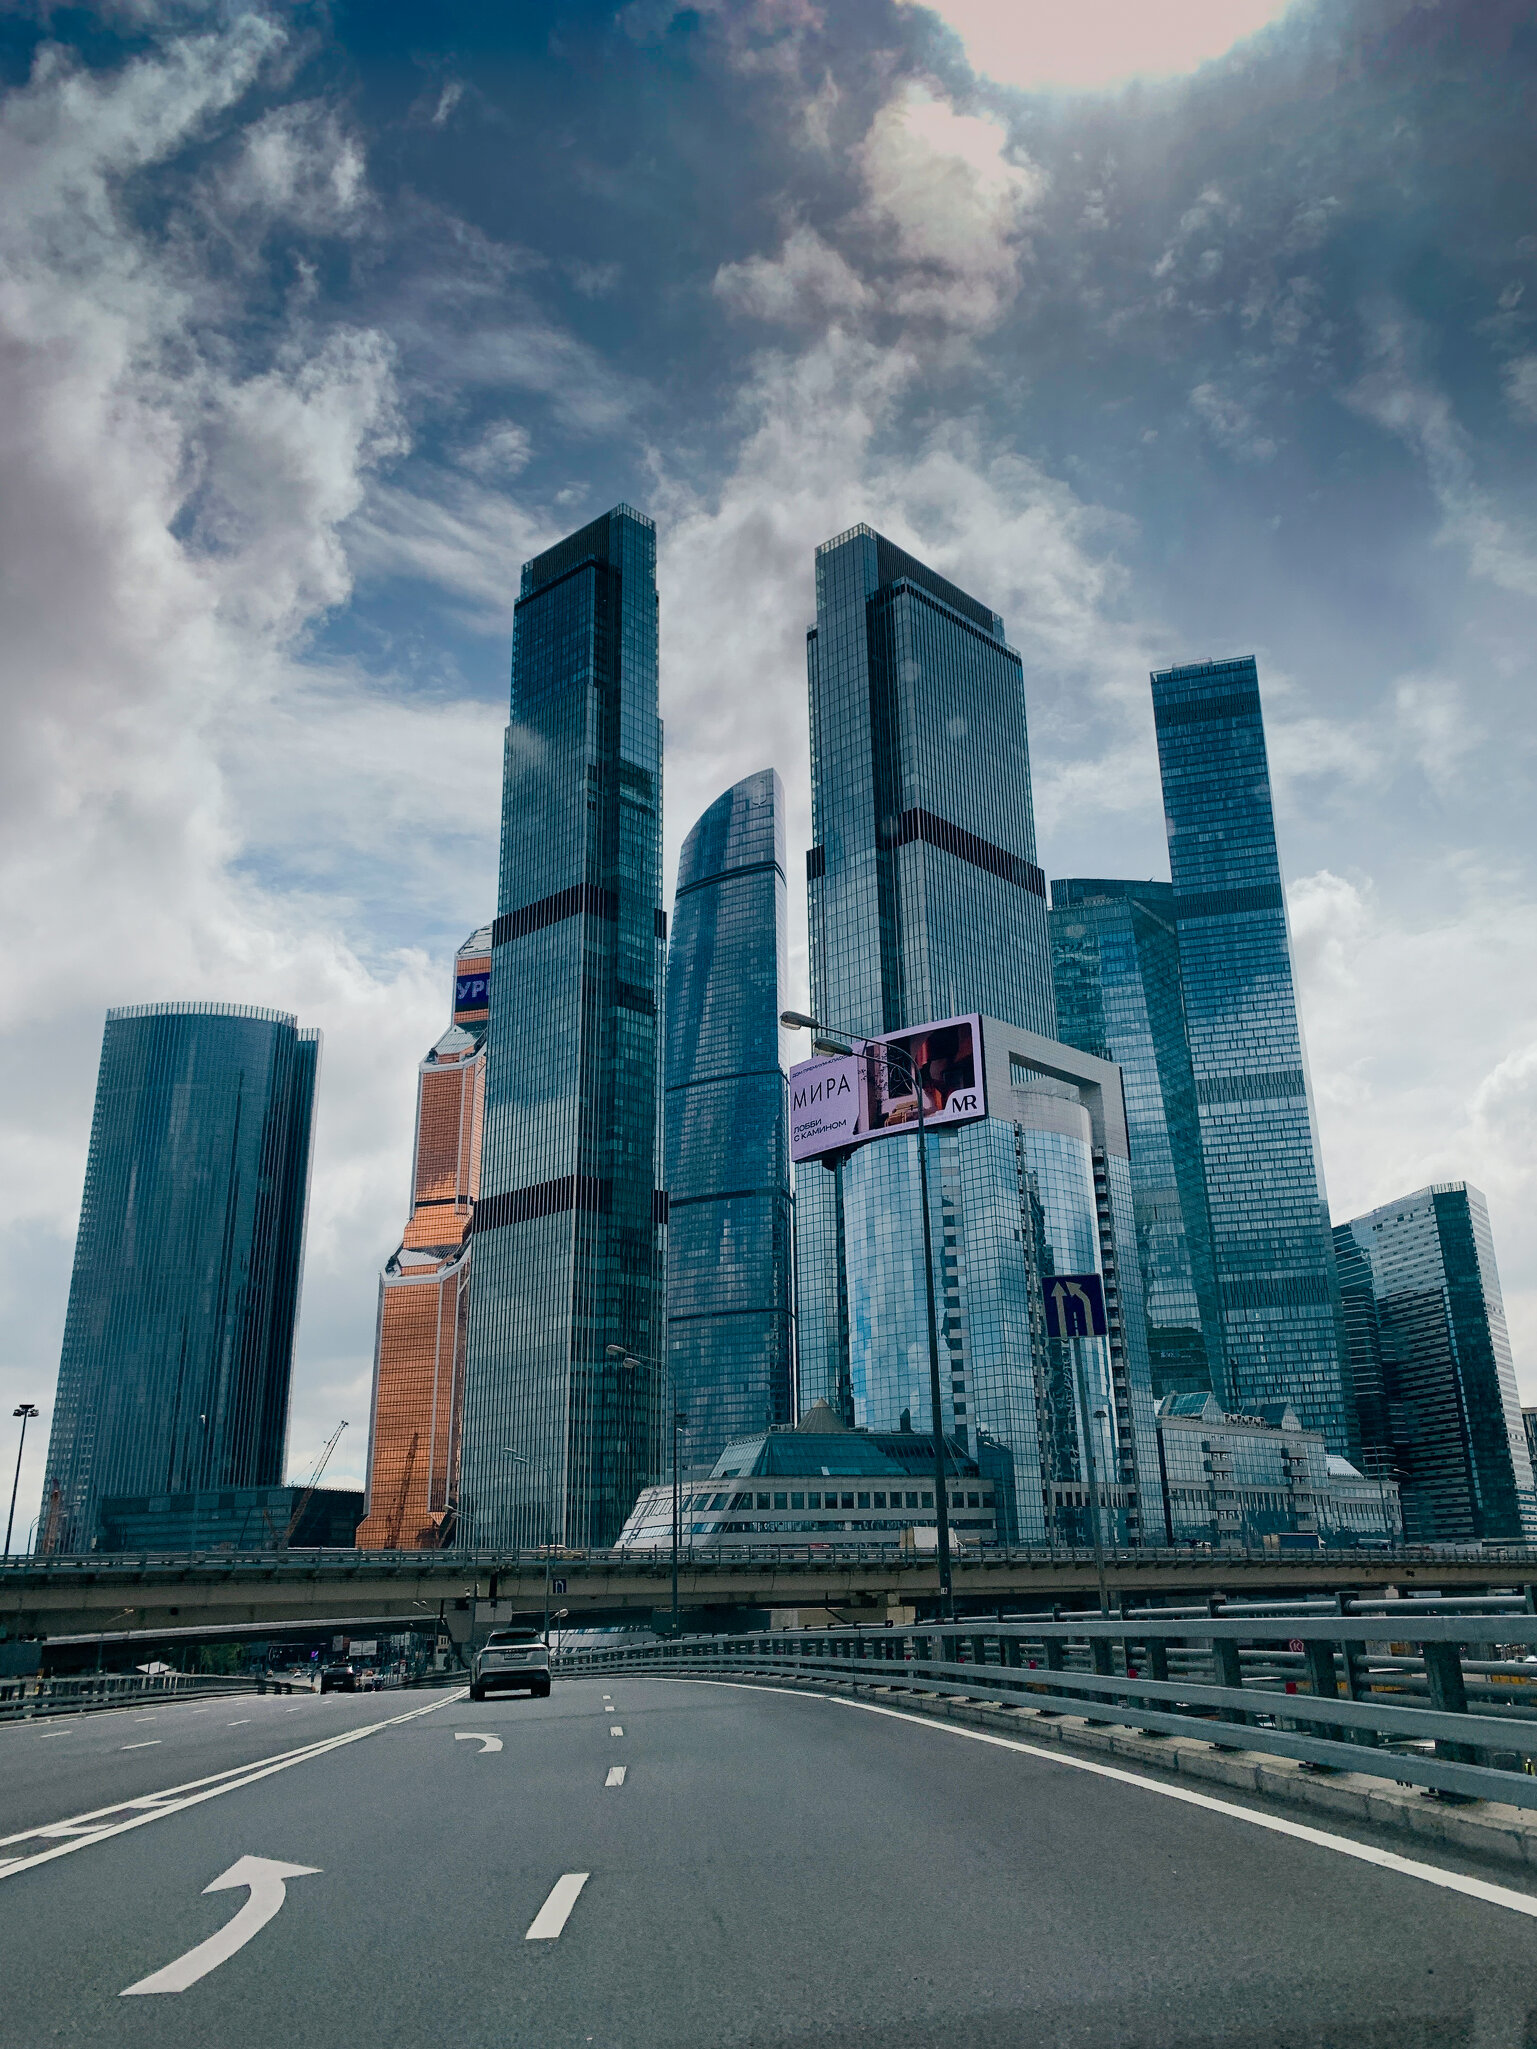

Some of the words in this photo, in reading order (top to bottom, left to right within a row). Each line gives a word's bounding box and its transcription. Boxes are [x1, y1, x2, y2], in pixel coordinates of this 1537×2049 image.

[793, 1074, 851, 1111] МИРА
[952, 1095, 978, 1113] MR
[793, 1118, 822, 1134] ЛОББИ
[801, 1119, 847, 1140] КАМИНОМ
